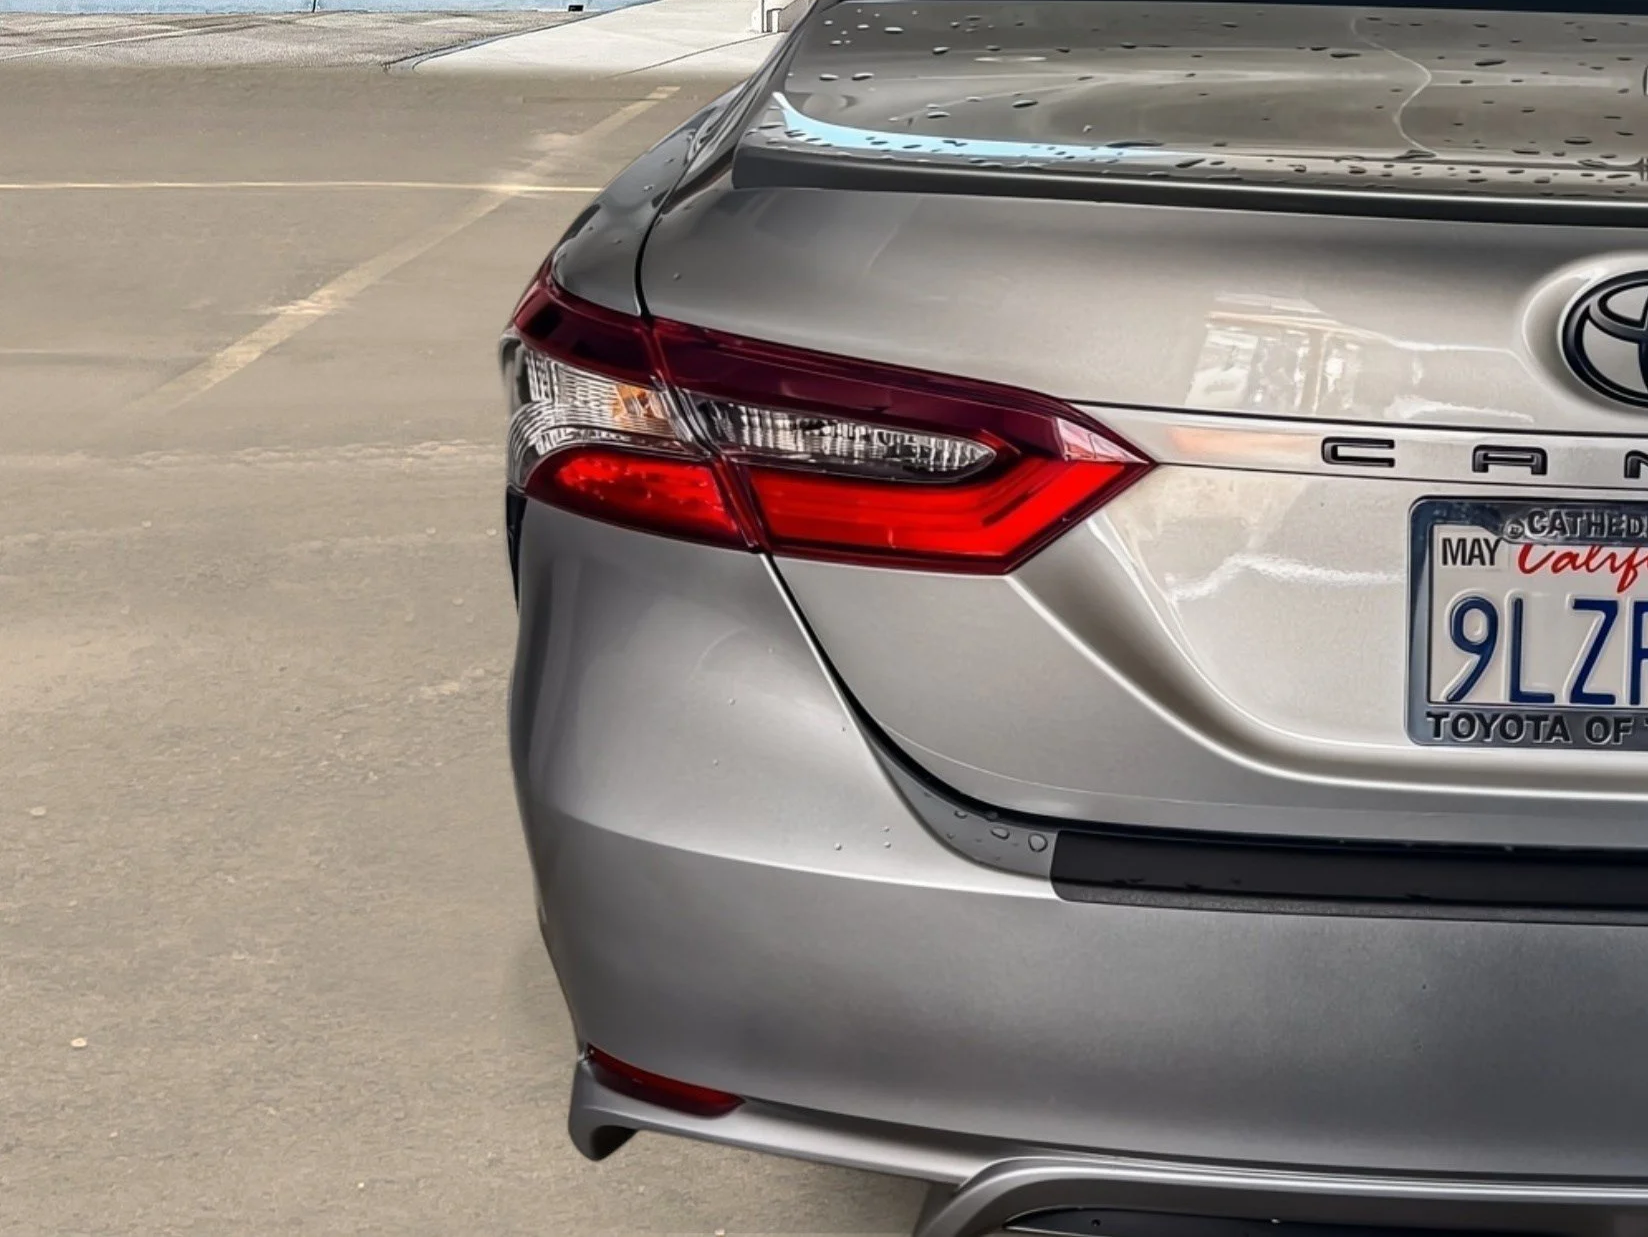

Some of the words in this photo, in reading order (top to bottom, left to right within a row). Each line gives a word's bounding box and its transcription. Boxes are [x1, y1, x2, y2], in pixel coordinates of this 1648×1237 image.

[1442, 537, 1501, 566] MAY
[1426, 711, 1571, 743] TOYOTA
[1585, 717, 1635, 744] OF
